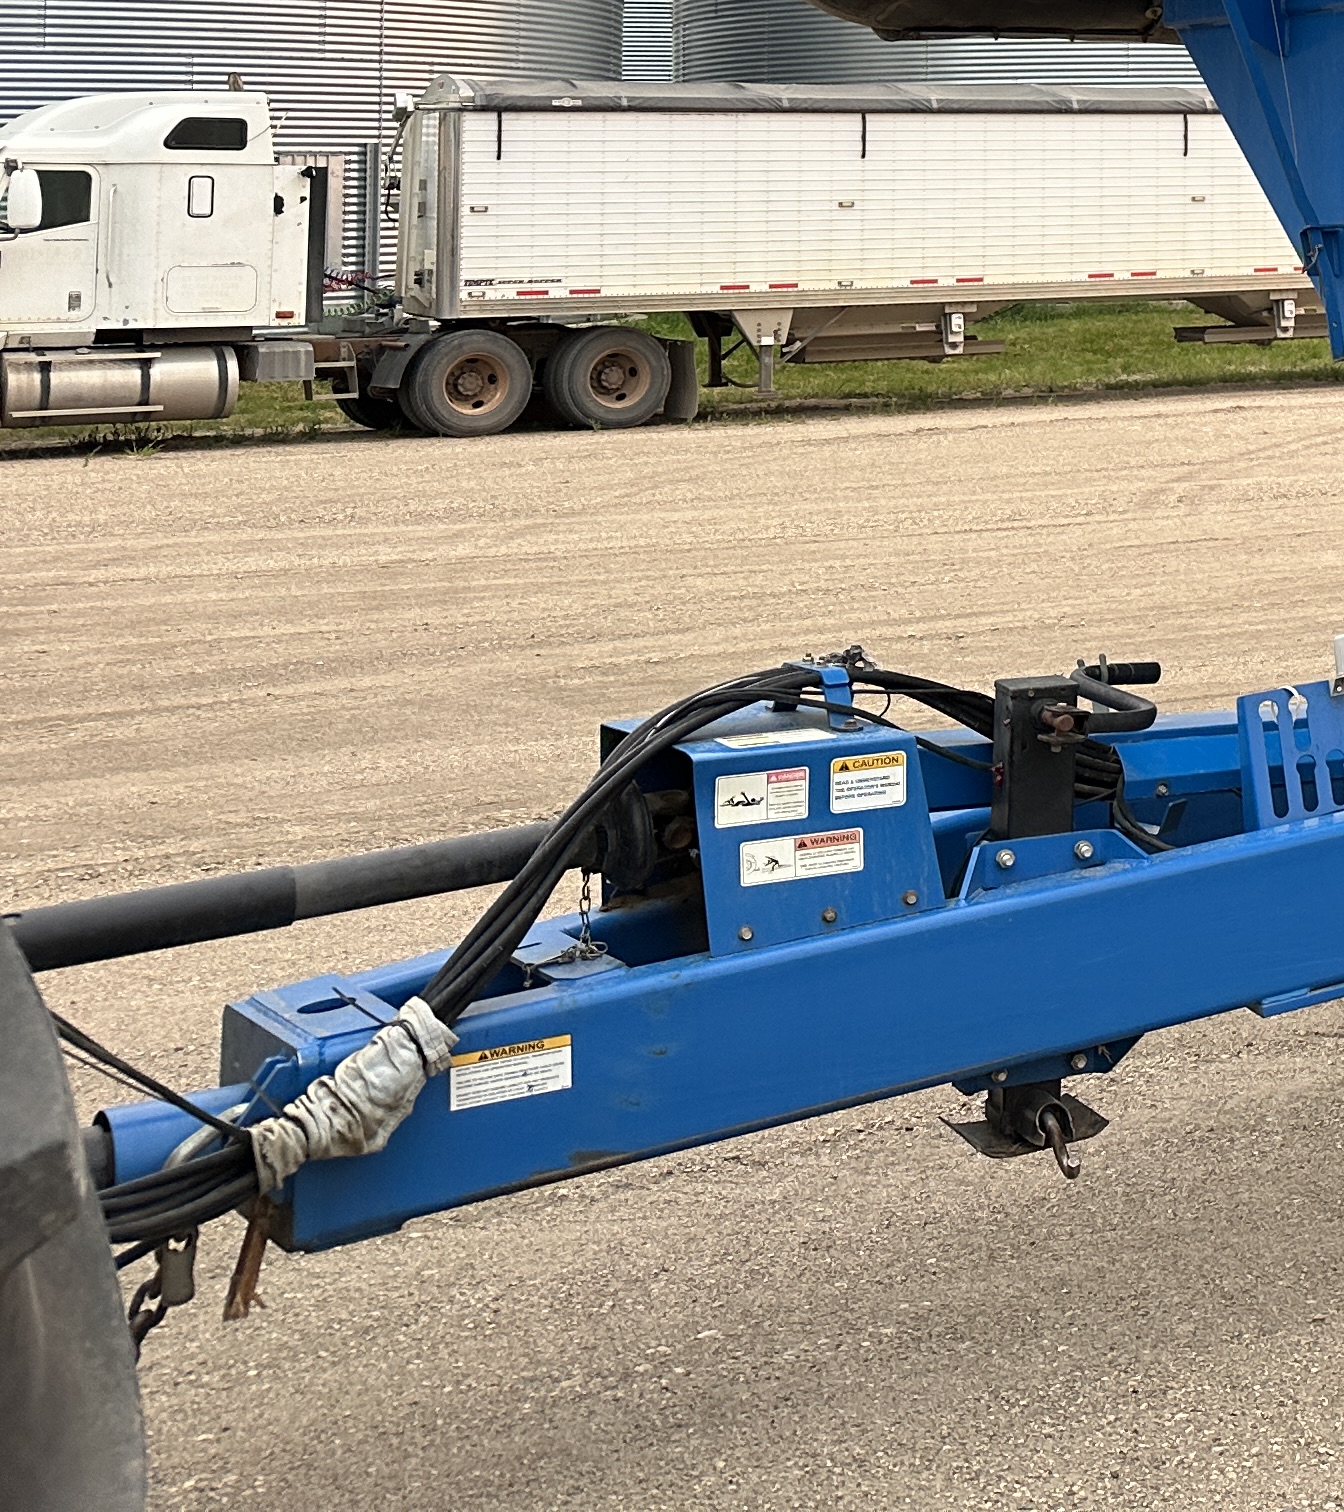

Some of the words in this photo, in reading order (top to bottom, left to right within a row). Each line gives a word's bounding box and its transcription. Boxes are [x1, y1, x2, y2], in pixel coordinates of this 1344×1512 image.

[852, 755, 899, 769] CAUTION
[810, 832, 857, 846] WARNING
[489, 1040, 545, 1059] WARNING
